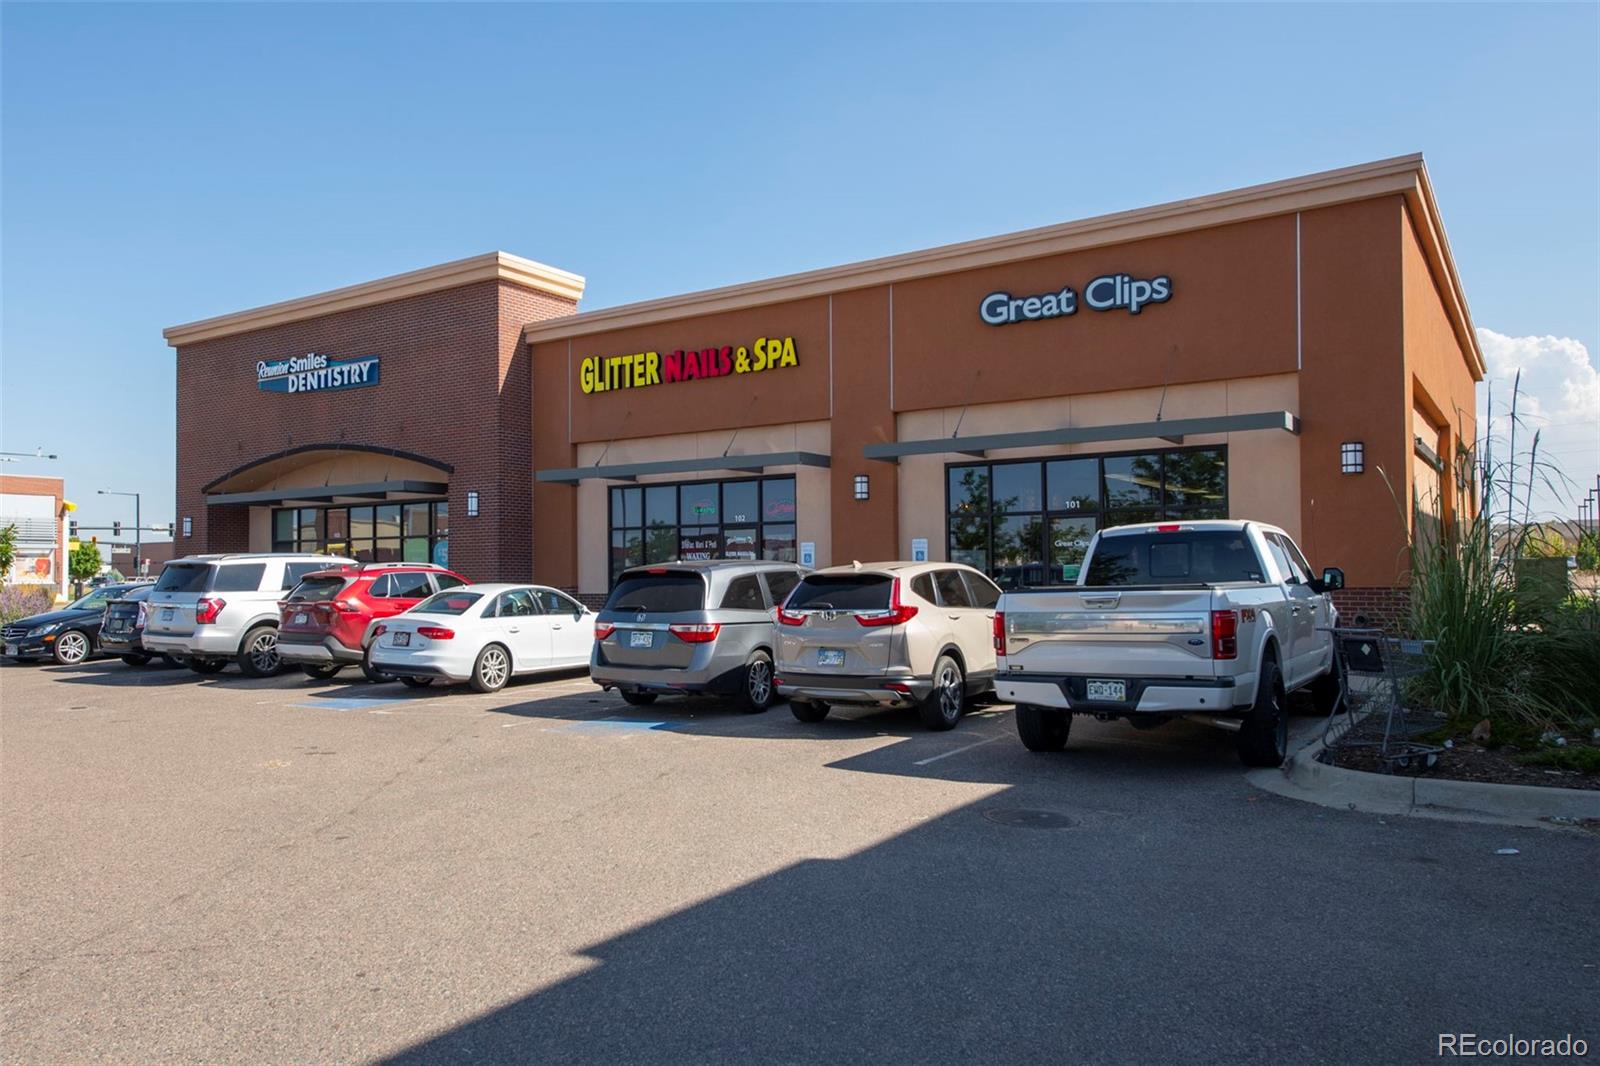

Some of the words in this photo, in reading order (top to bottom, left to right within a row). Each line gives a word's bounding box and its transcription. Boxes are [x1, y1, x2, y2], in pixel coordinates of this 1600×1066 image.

[980, 290, 1075, 324] Great
[1085, 275, 1170, 313] Clips
[288, 362, 370, 393] DENTISTRY
[289, 353, 327, 373] Smiles
[580, 352, 661, 394] GLITTER
[664, 346, 732, 383] NAILS
[735, 347, 751, 374] &
[753, 336, 798, 372] SPA
[1065, 501, 1080, 509] 101
